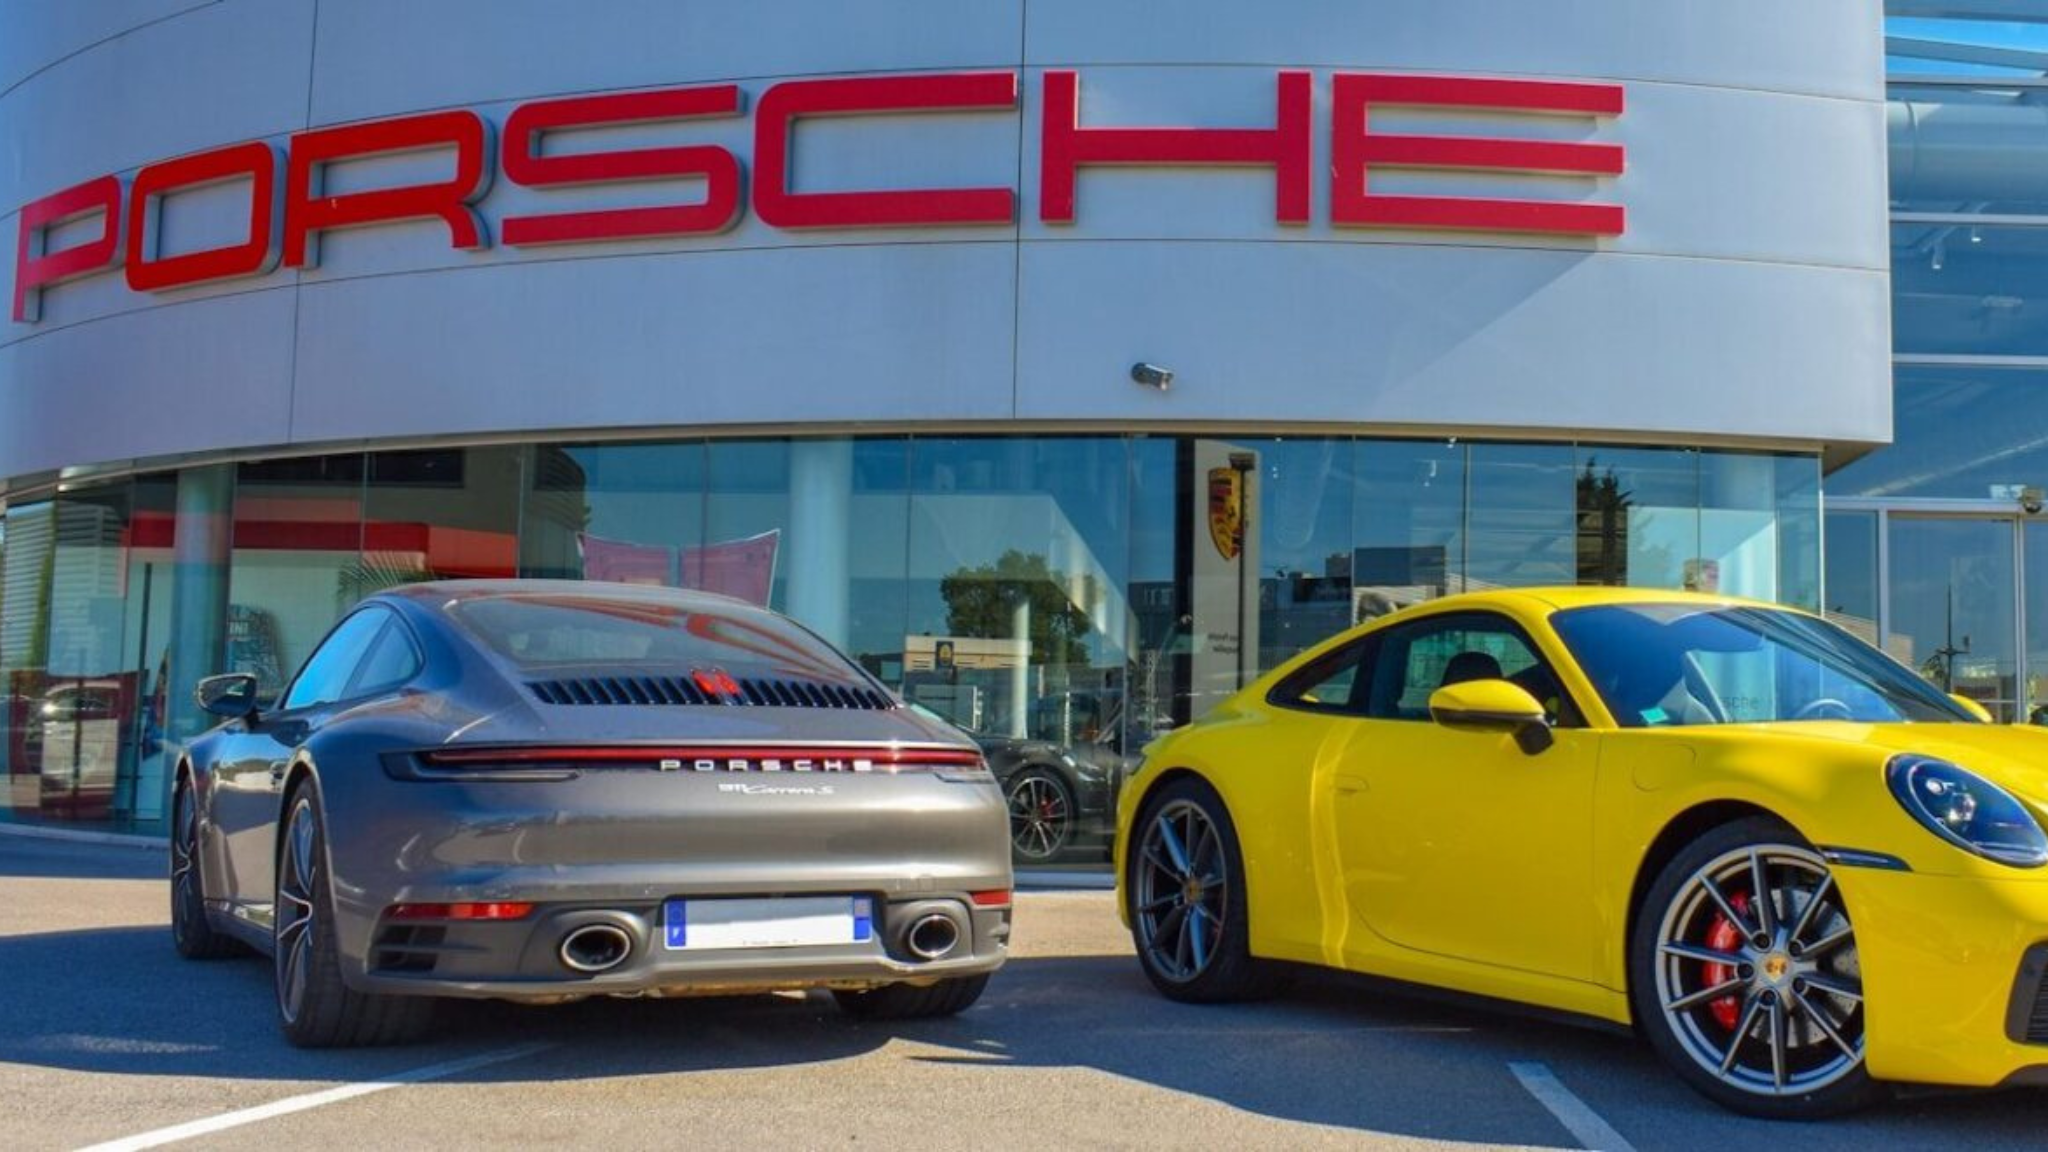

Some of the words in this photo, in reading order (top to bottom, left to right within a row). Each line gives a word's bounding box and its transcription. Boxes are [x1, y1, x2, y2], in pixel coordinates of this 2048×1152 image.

[13, 71, 1625, 323] PORSCHE
[744, 784, 816, 795] Carrera
[818, 783, 836, 795] S
